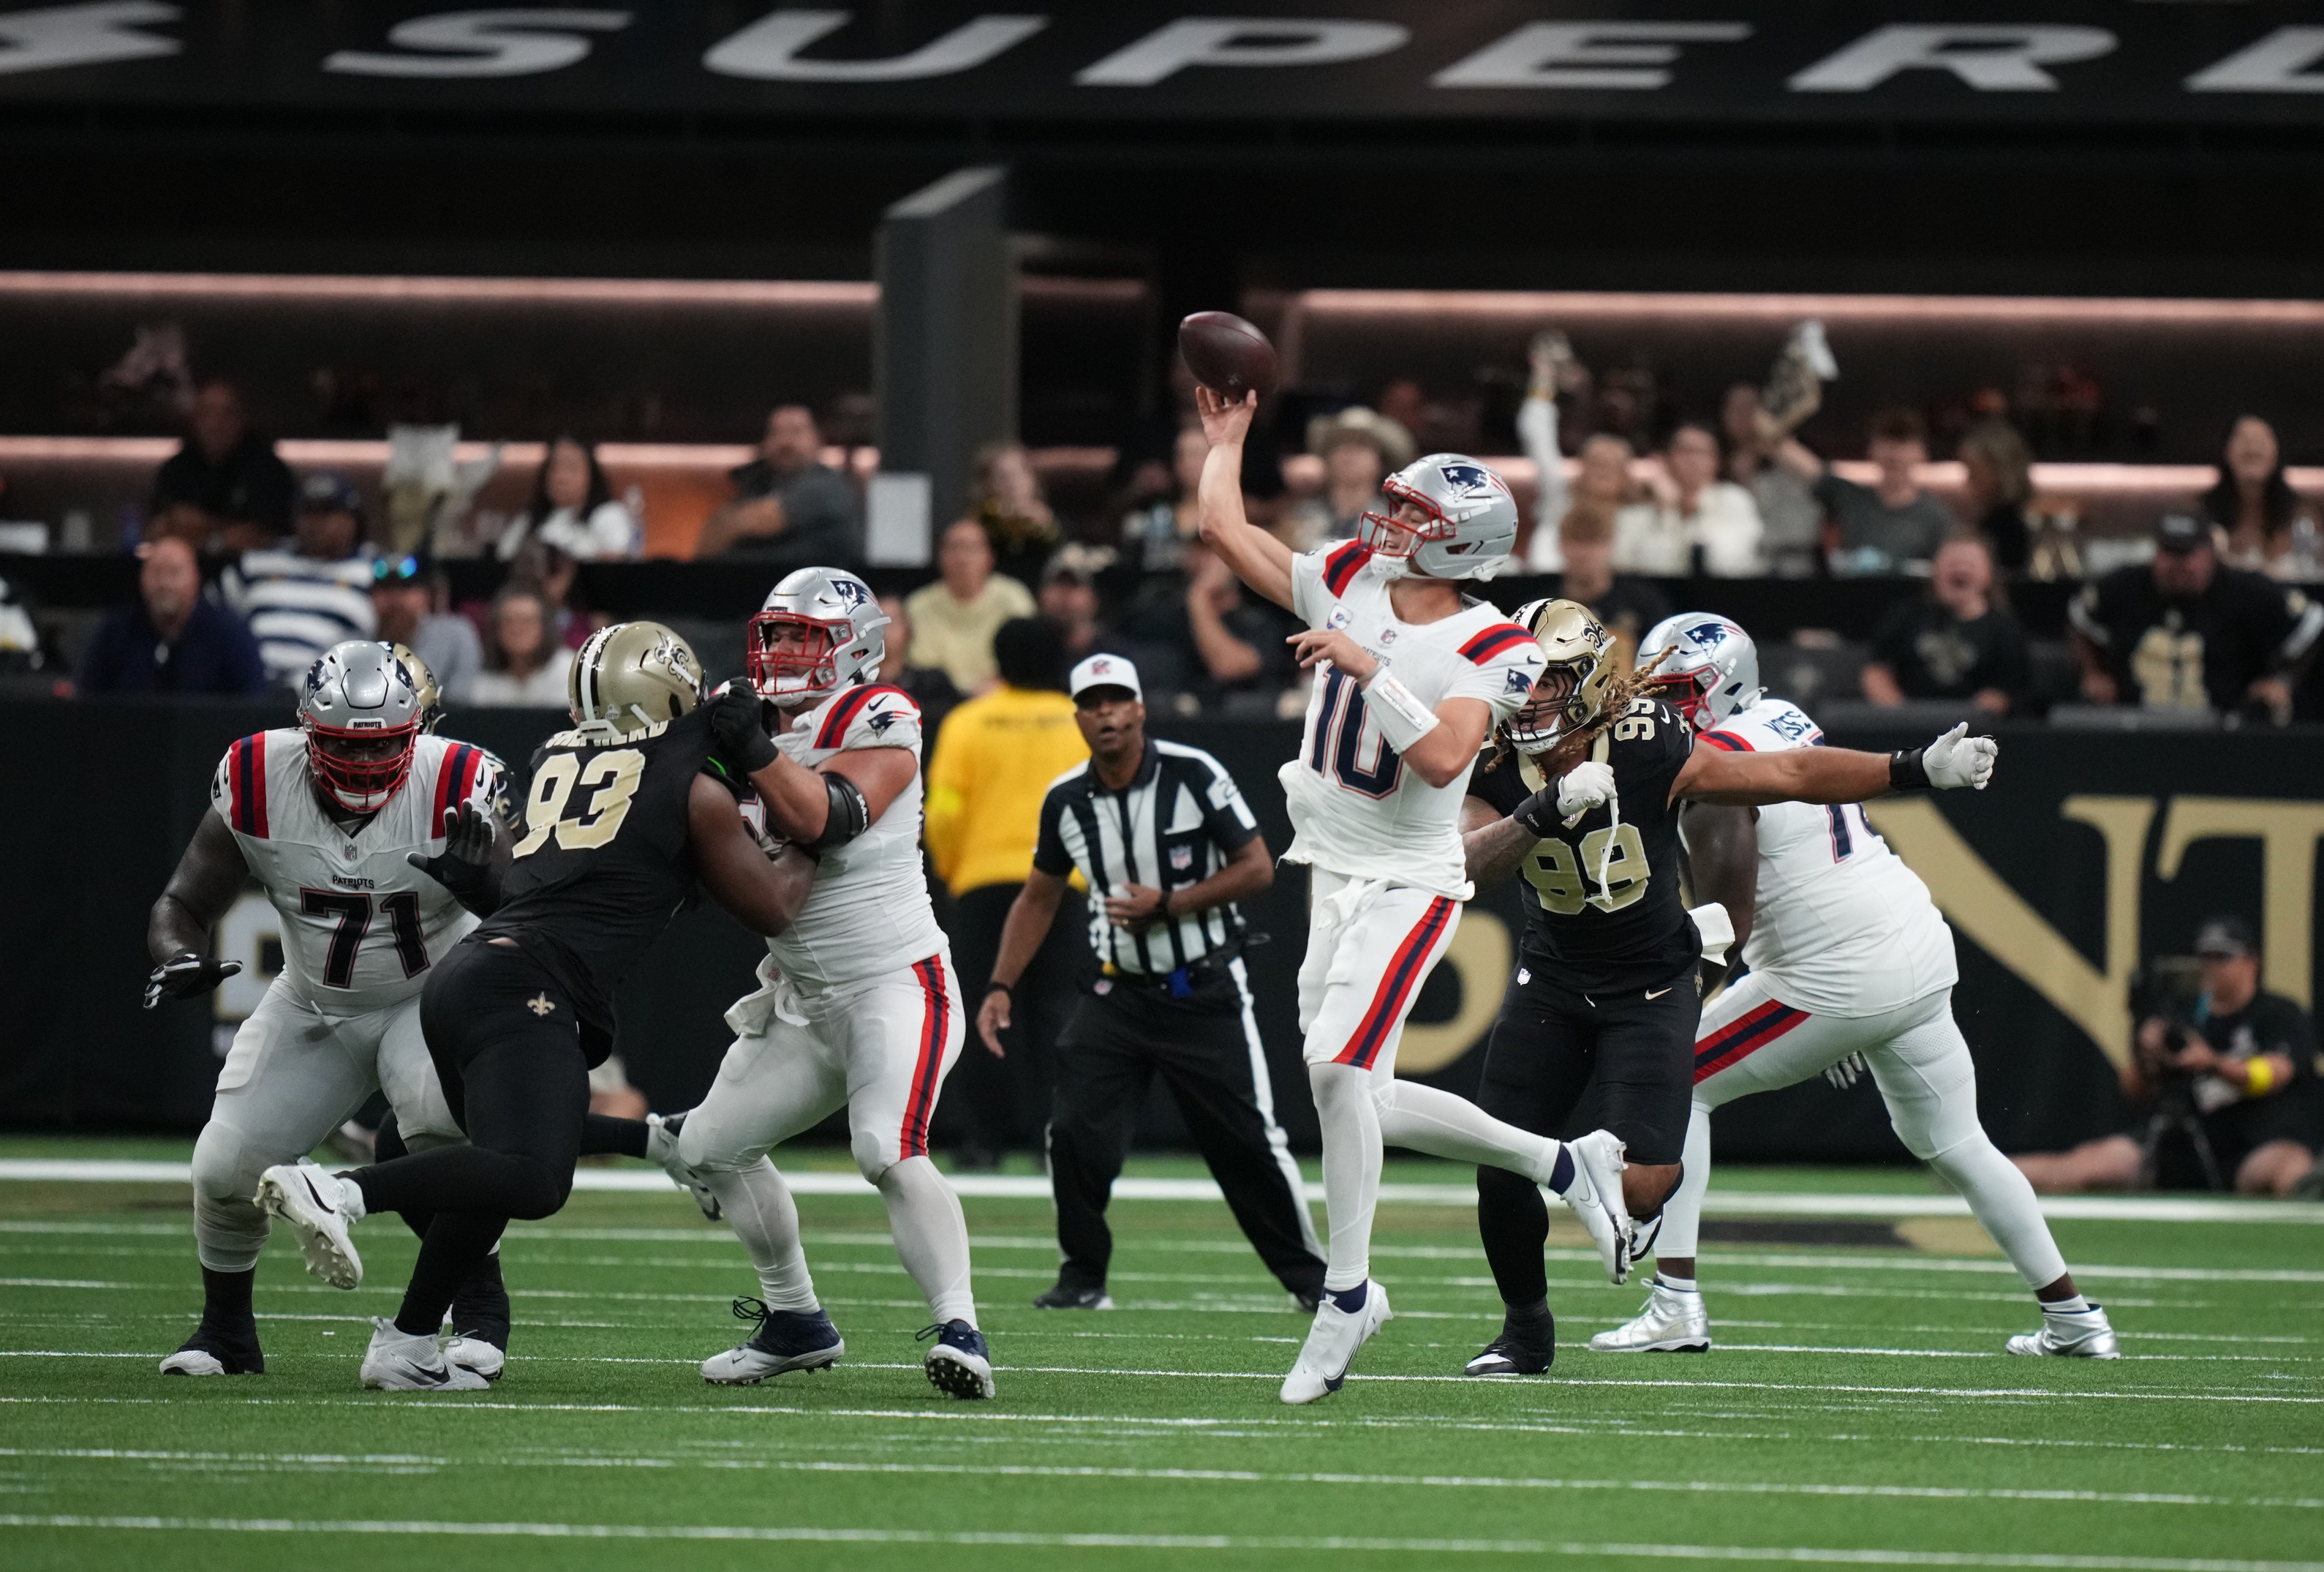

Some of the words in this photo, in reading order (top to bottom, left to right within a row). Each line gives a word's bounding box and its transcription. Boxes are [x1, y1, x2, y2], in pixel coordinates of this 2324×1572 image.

[353, 721, 382, 729] PATRIOTS
[1309, 661, 1404, 800] 10
[512, 748, 646, 860] 93
[333, 875, 374, 890] PATRIOTS
[300, 887, 431, 989] 71
